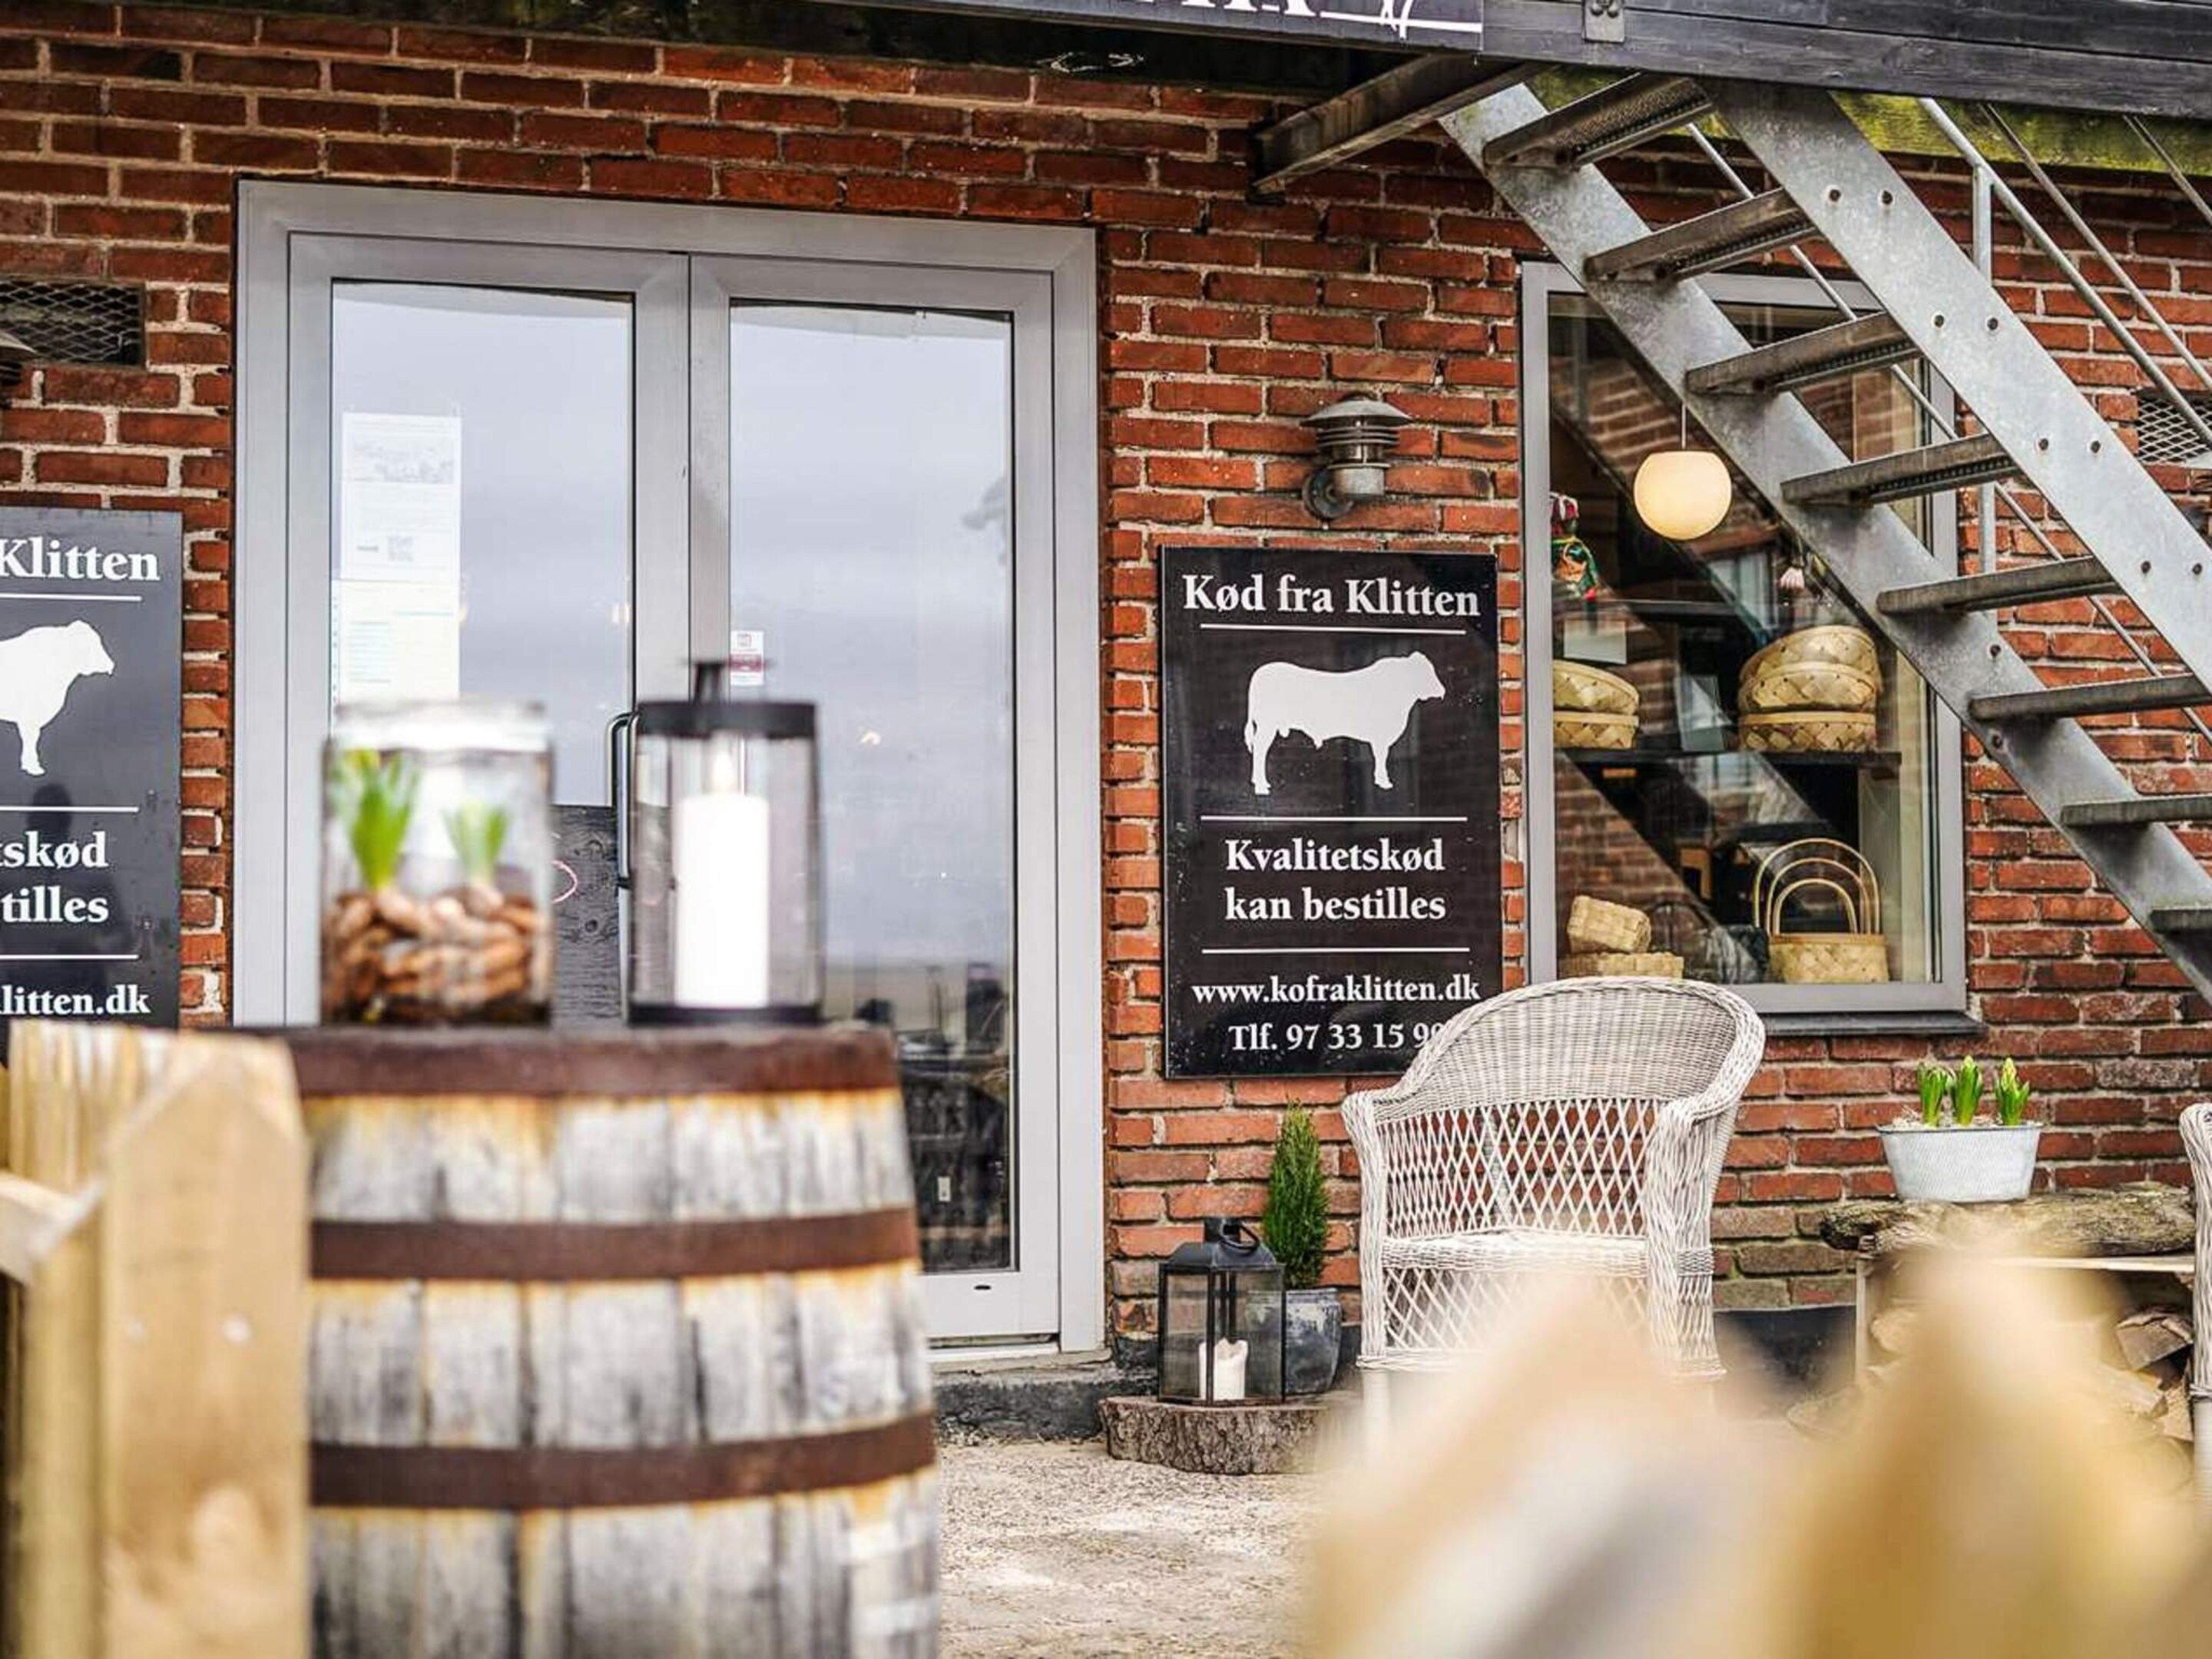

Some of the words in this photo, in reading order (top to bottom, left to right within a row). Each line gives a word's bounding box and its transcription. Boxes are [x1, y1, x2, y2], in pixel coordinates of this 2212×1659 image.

[0, 536, 161, 581] Klitten
[1183, 574, 1267, 614] Kød
[1277, 575, 1334, 613] fra
[1346, 578, 1480, 616] Klitten
[0, 830, 109, 869] skød
[1225, 837, 1445, 872] Kvalitetskød
[0, 886, 109, 923] tilles
[1224, 886, 1293, 920] kan
[1301, 886, 1445, 920] bestilles
[0, 984, 151, 1015] litten.dk
[1191, 973, 1481, 1003] www.kofraklitten.dk
[1228, 1022, 1277, 1050] Tlf.
[1286, 1024, 1320, 1050] 97
[1328, 1024, 1363, 1049] 33
[1373, 1023, 1404, 1048] 15
